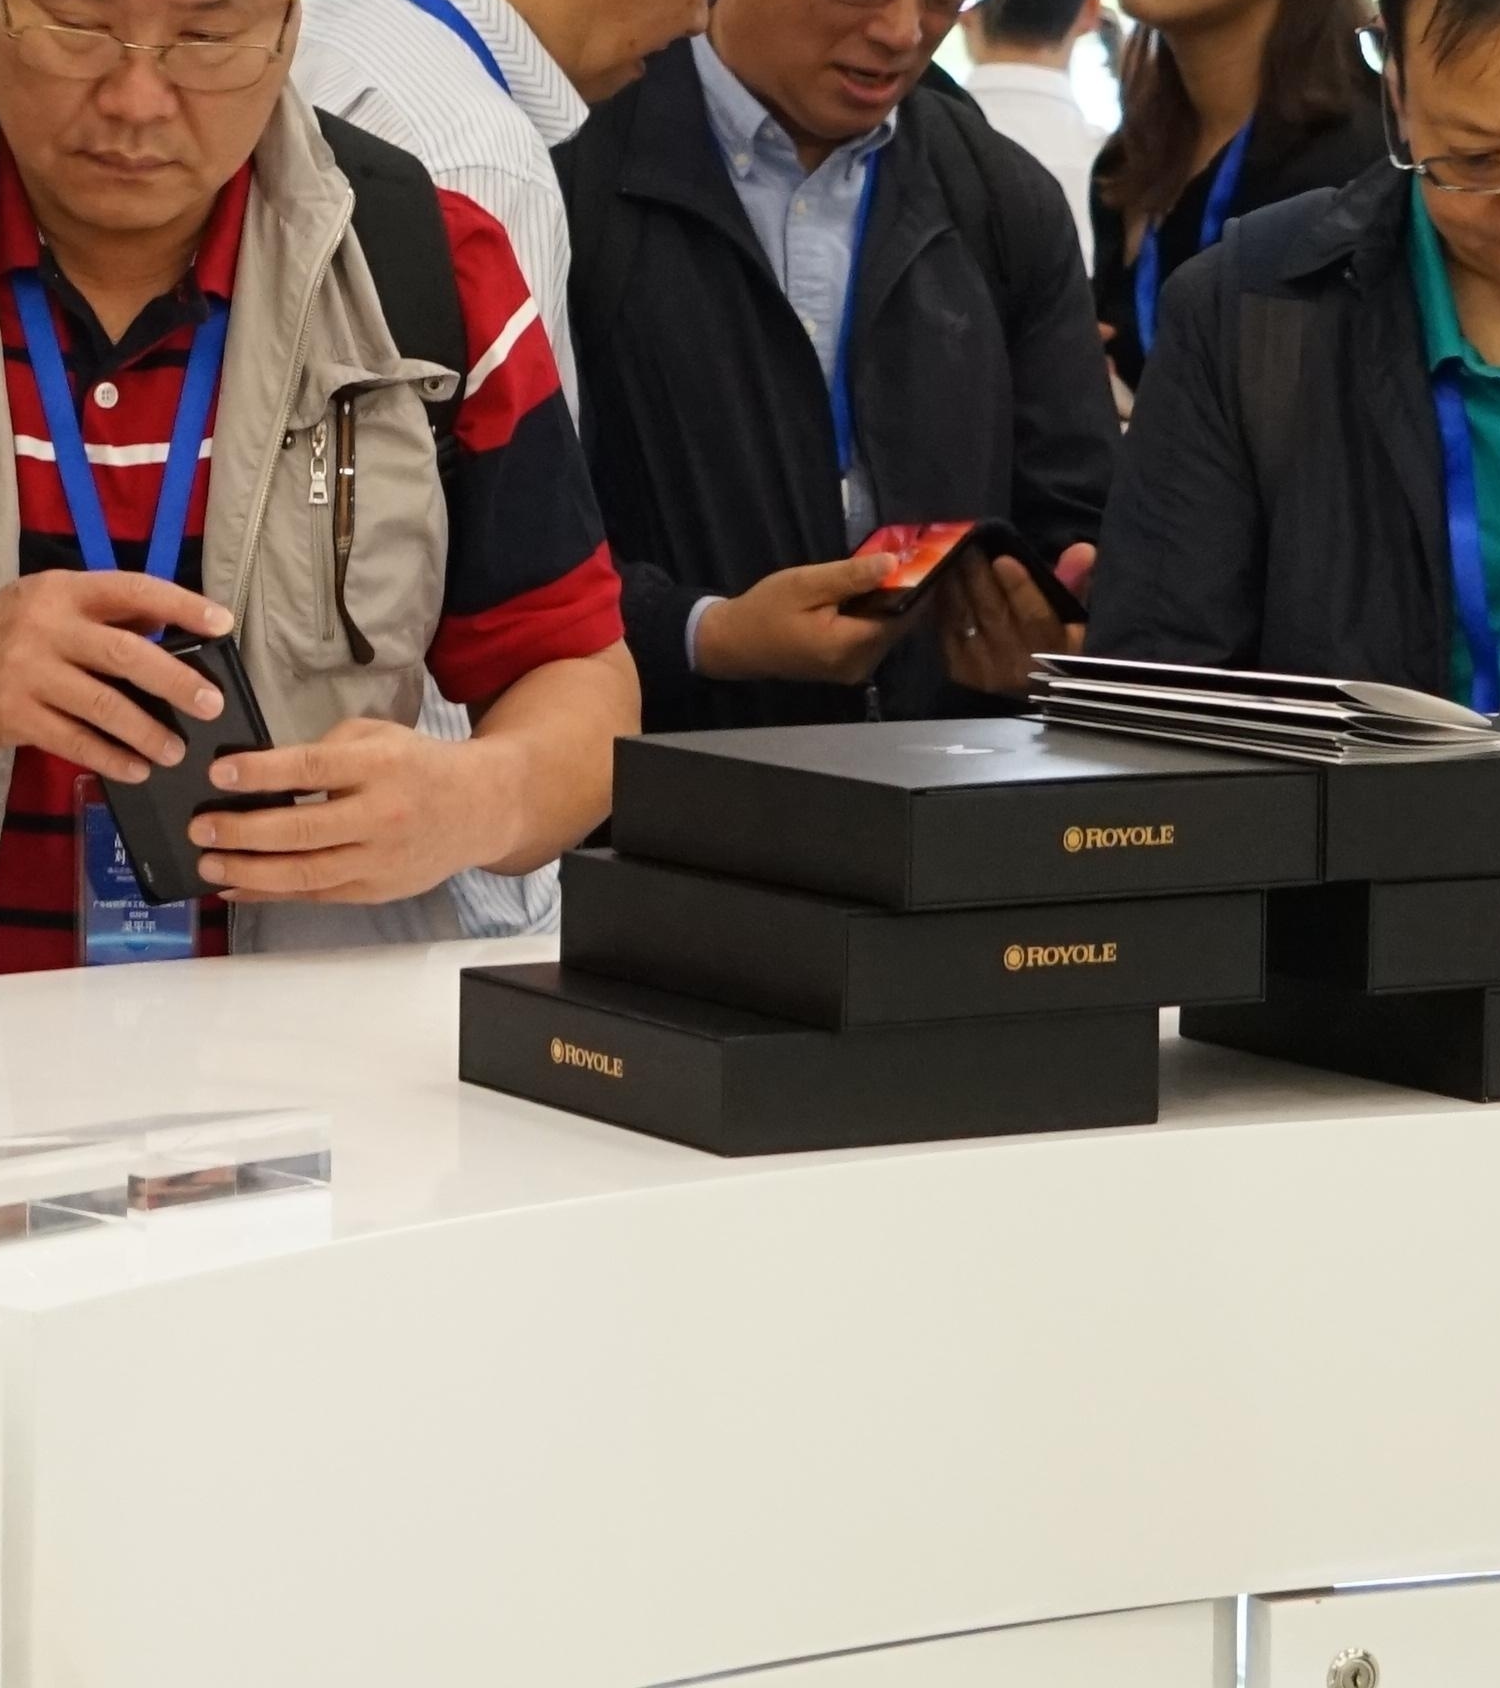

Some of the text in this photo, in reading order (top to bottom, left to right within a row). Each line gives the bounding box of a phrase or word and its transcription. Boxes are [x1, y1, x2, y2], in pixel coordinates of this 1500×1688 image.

[1084, 824, 1175, 849] ROYOLE
[1025, 942, 1117, 968] ROYOLE
[564, 1043, 624, 1079] ROYOLE
